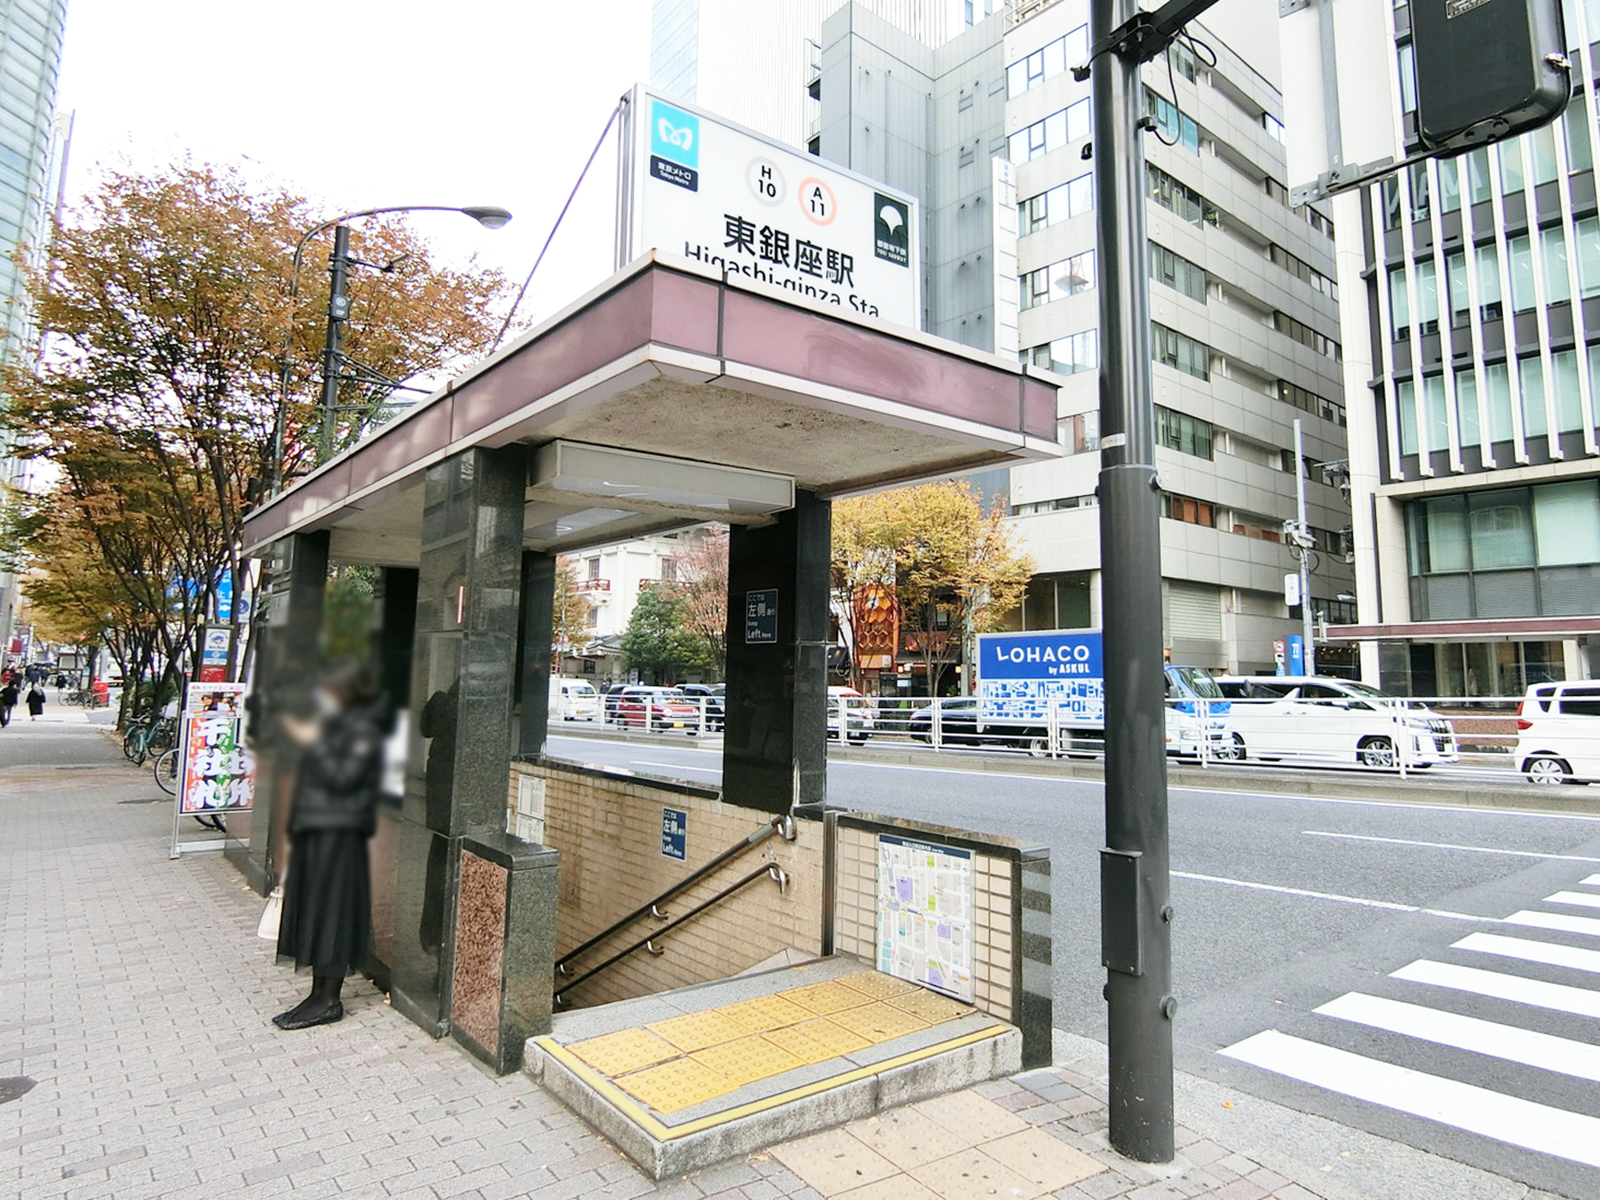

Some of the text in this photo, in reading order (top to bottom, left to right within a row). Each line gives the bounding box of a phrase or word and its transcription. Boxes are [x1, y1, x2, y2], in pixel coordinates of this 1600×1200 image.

[761, 165, 772, 181] H
[758, 178, 777, 198] 10
[813, 186, 823, 201] A
[810, 199, 825, 217] 11
[723, 213, 855, 289] 東銀座駅
[747, 628, 761, 639] Left
[996, 645, 1090, 663] LOHACO
[1048, 663, 1091, 676] by ASKUL
